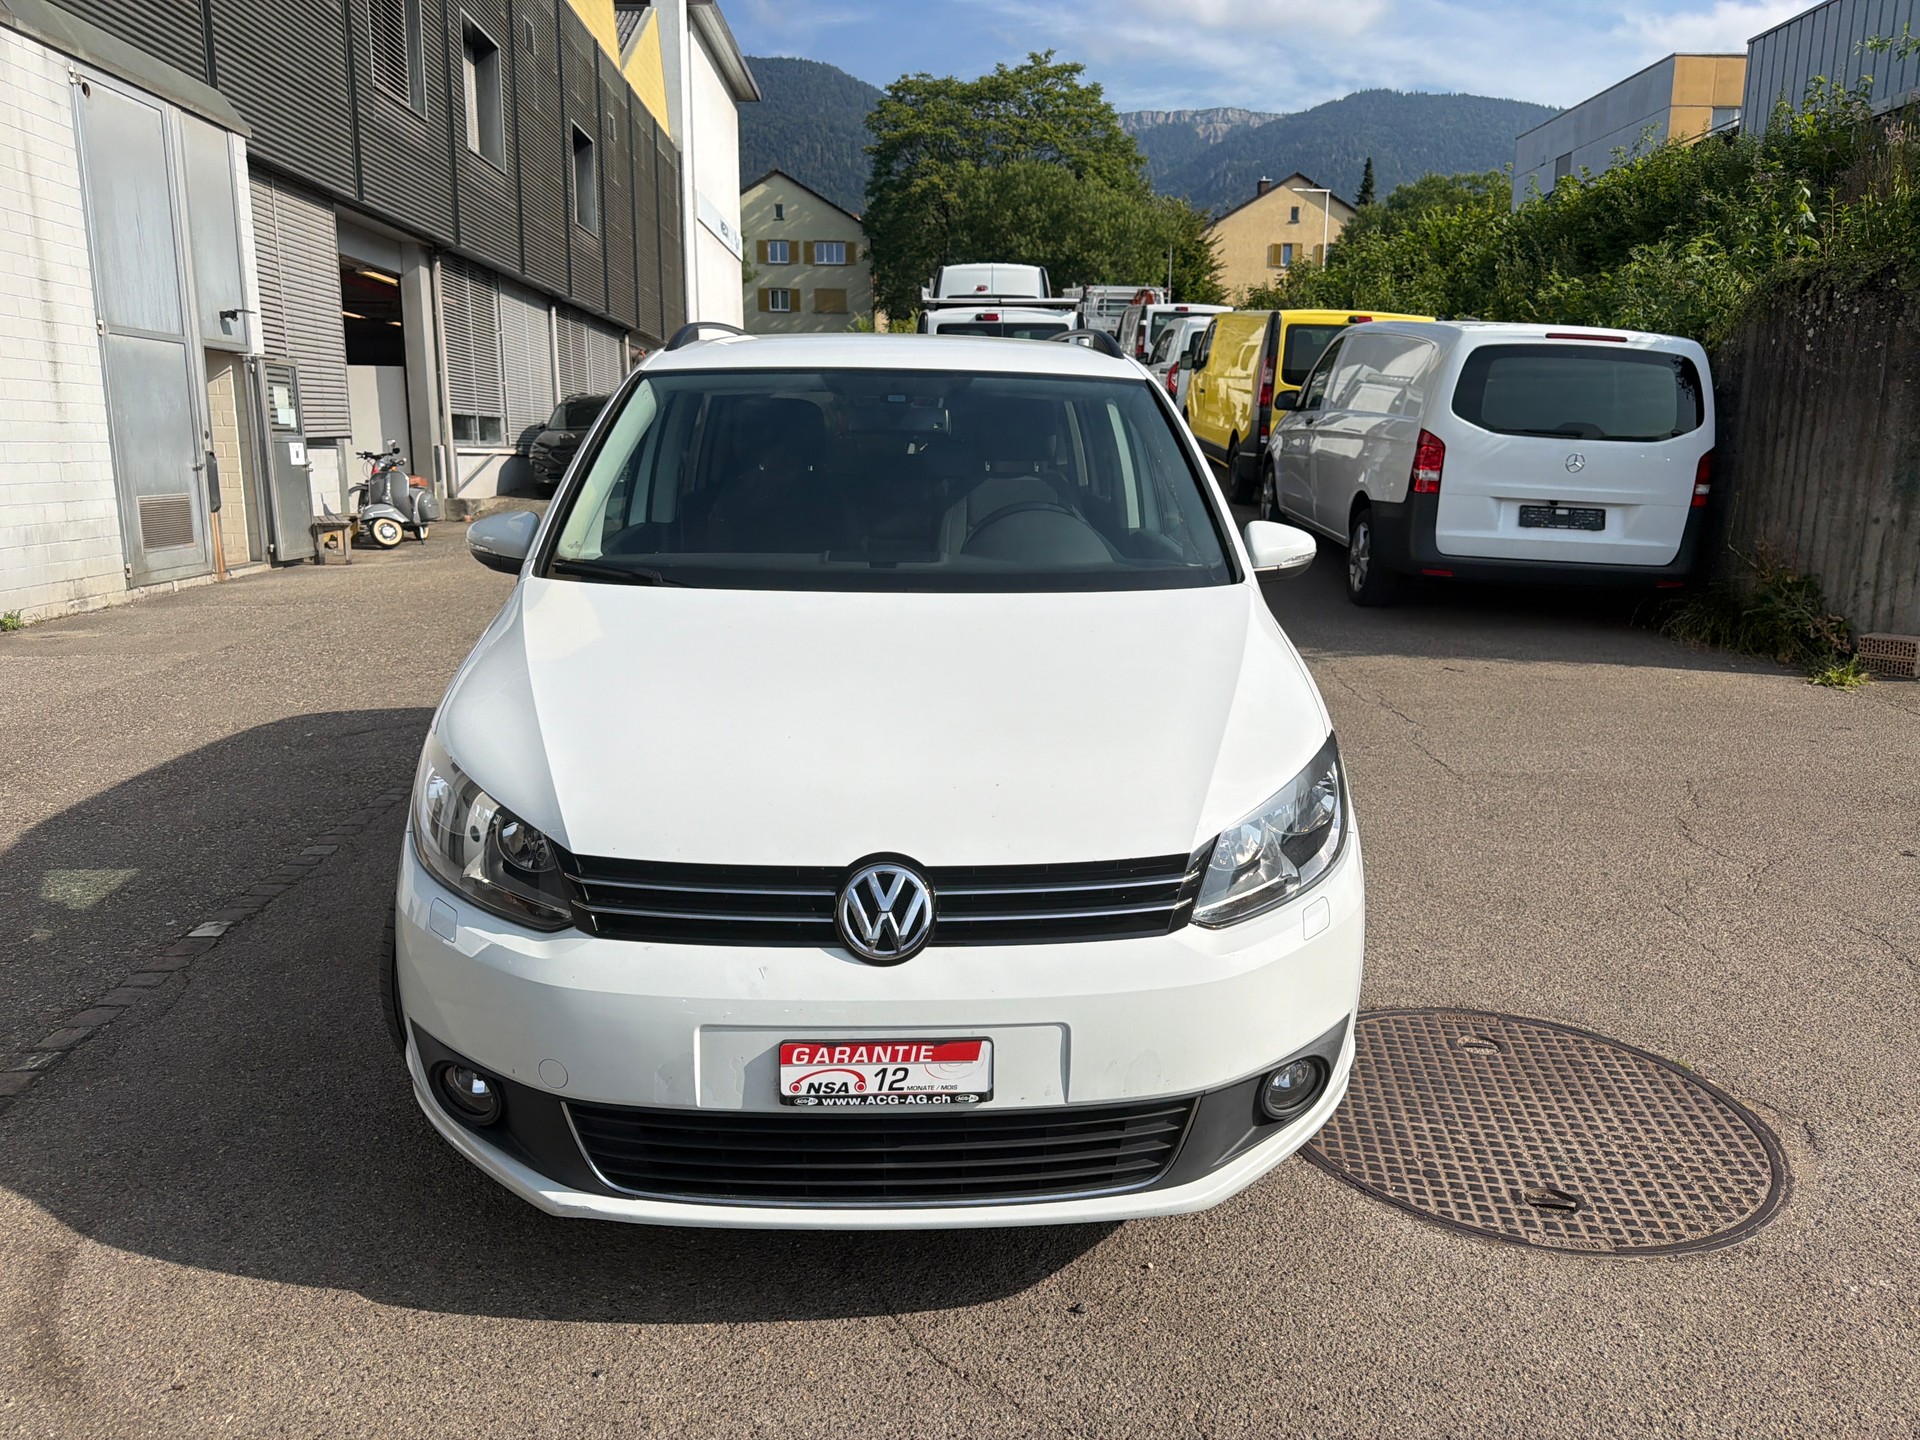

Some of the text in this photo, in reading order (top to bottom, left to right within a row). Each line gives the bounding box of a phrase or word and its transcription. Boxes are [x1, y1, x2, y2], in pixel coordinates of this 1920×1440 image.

[792, 1045, 935, 1064] GARANTIE
[873, 1067, 909, 1091] 12
[806, 1082, 849, 1094] NSA
[822, 1094, 951, 1106] www.ACG-AG.ch
